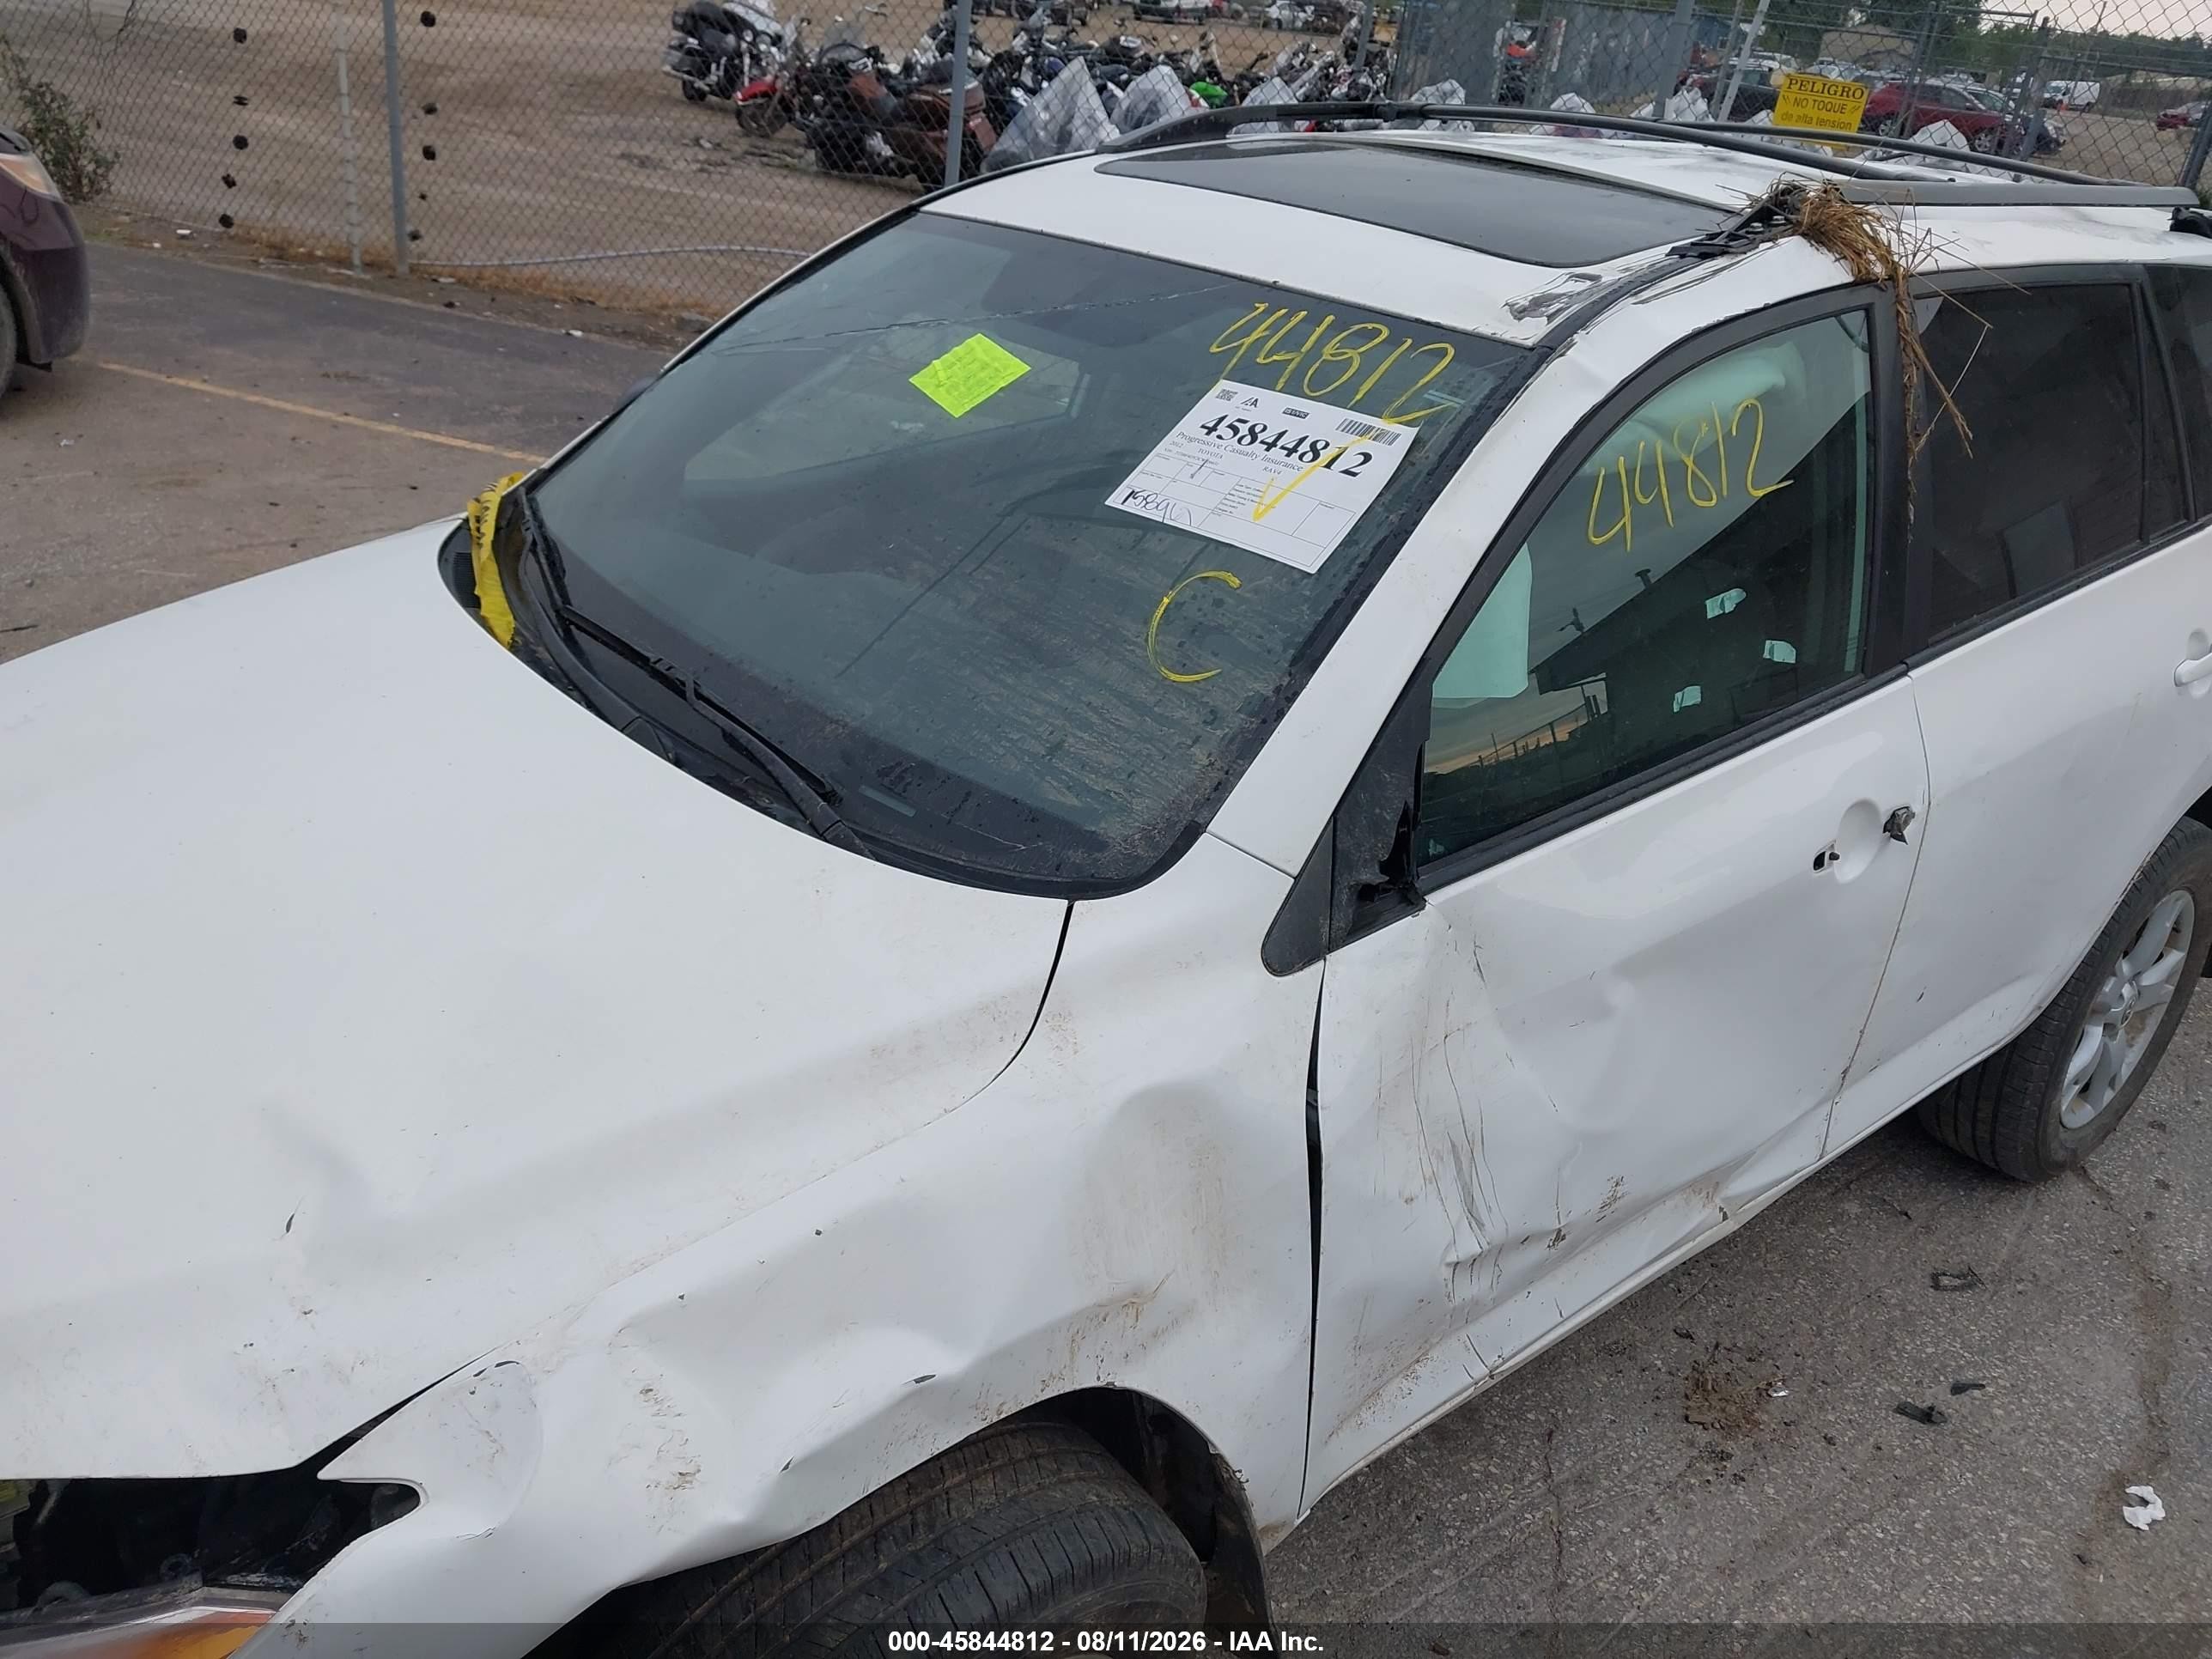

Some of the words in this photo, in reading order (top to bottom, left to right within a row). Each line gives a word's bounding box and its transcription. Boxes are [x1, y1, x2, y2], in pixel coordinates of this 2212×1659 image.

[1787, 77, 1864, 100] PELIGRO
[1793, 96, 1808, 109] NO
[1812, 99, 1848, 114] TOQUE
[1781, 111, 1793, 121] de
[1209, 302, 1458, 424] 44812
[1176, 431, 1223, 449] Progressive
[1224, 445, 1261, 461] Casualty
[1261, 451, 1304, 472] Insurance
[1200, 414, 1373, 477] 45844812
[1589, 398, 1795, 552] 44812
[1147, 570, 1242, 682] C
